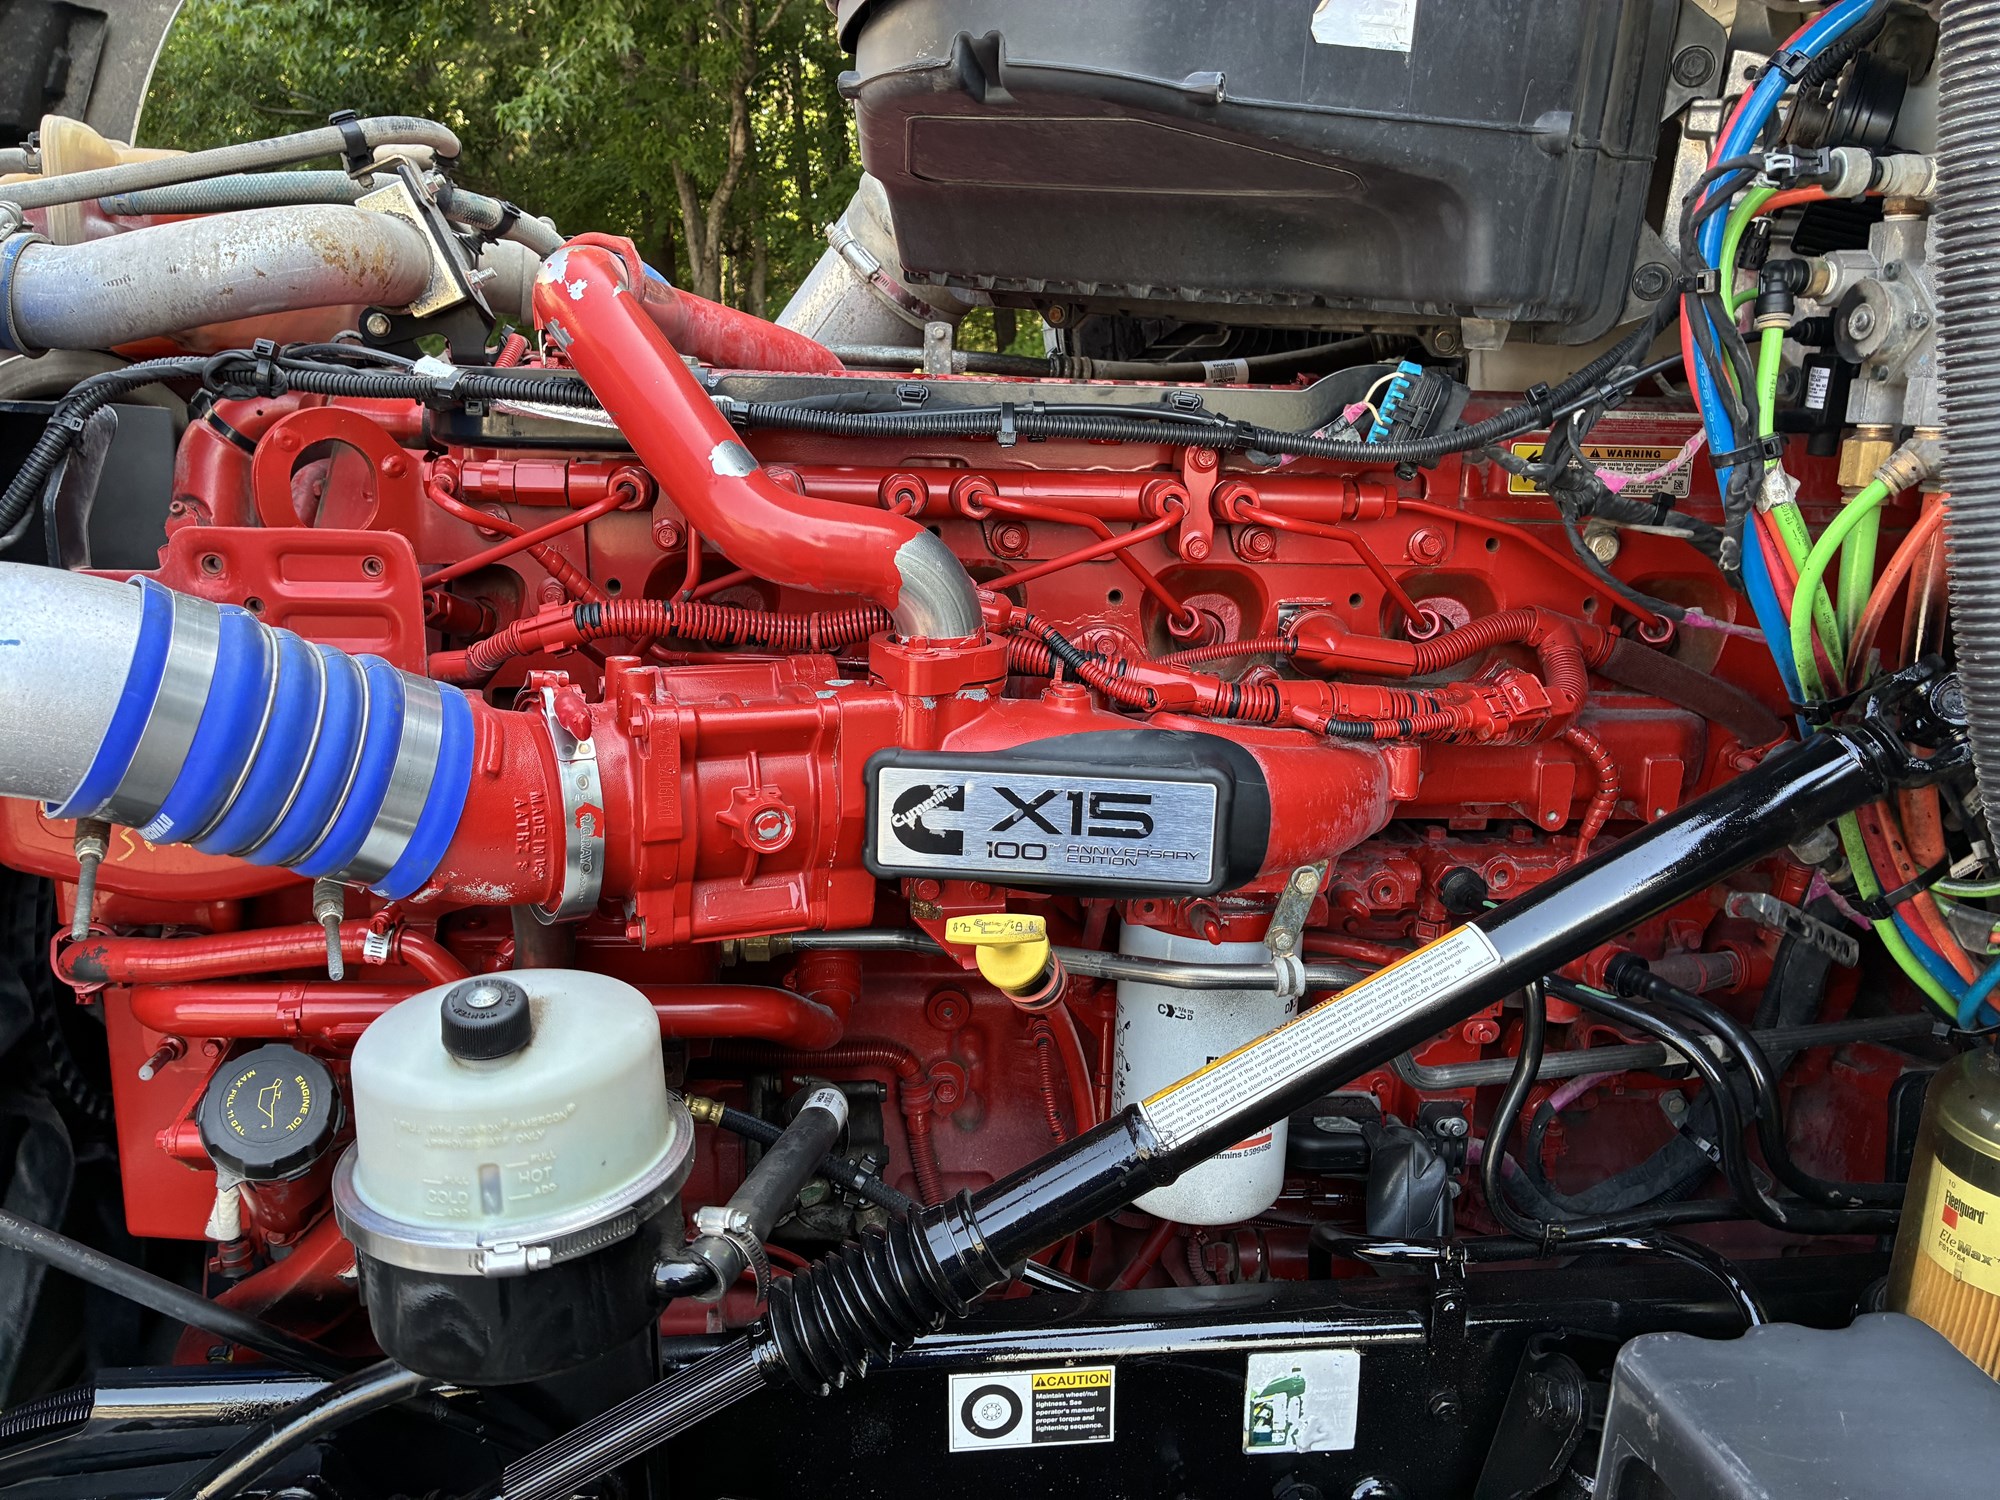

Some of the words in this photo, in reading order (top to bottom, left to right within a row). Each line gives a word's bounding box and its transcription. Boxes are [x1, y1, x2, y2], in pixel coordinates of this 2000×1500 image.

[1606, 449, 1661, 459] WARNING
[891, 785, 959, 828] Cummins
[988, 786, 1154, 839] X15
[1066, 843, 1200, 861] ANNIVERSARY
[1066, 854, 1138, 867] EDITION
[1149, 1099, 1179, 1119] repaired,
[1177, 1084, 1205, 1103] removed
[1211, 1056, 1254, 1083] disassembled
[1260, 1047, 1272, 1057] any
[1272, 1038, 1288, 1051] way,
[1299, 1024, 1311, 1034] the
[1310, 1010, 1337, 1029] steering
[1335, 1000, 1354, 1015] angle
[1353, 989, 1375, 1004] sensor
[1380, 968, 1411, 990] replaced,
[1409, 962, 1421, 972] the
[1420, 948, 1447, 968] steering
[1445, 939, 1464, 953] angle
[1153, 1109, 1176, 1125] sensor
[1174, 1099, 1192, 1113] must
[1199, 1073, 1238, 1099] recalibrated.
[1242, 1064, 1255, 1075] the
[1253, 1042, 1293, 1069] recalibration
[1297, 1033, 1310, 1044] not
[1309, 1015, 1343, 1039] performed
[1341, 1009, 1353, 1019] the
[1352, 995, 1378, 1014] stability
[1376, 982, 1400, 1000] control
[1398, 970, 1423, 988] system
[1421, 963, 1434, 974] will
[1432, 957, 1445, 968] not
[1443, 943, 1471, 962] function
[1184, 1101, 1205, 1117] which
[1203, 1095, 1219, 1108] may
[1216, 1083, 1236, 1099] result
[1246, 1069, 1262, 1082] loss
[1267, 1053, 1291, 1070] control
[1297, 1042, 1314, 1055] your
[1311, 1028, 1335, 1045] vehicle
[1333, 1021, 1348, 1033] and
[1346, 1006, 1375, 1027] personal
[1373, 996, 1393, 1012] injury
[1398, 980, 1420, 996] death.
[1418, 973, 1434, 986] Any
[1431, 961, 1455, 979] repairs
[1203, 1106, 1217, 1118] any
[1214, 1097, 1230, 1111] part
[1235, 1087, 1248, 1098] the
[1246, 1073, 1274, 1093] steering
[1271, 1060, 1296, 1079] system
[1294, 1051, 1312, 1065] must
[1319, 1028, 1353, 1052] performed
[1368, 1000, 1403, 1023] authorized
[1401, 984, 1431, 1005] PACCAR
[1429, 972, 1453, 989] dealer.
[1185, 1081, 1196, 1091] the
[1195, 1067, 1221, 1086] steering
[1220, 1055, 1244, 1072] system
[1280, 1020, 1307, 1038] steering
[236, 1070, 256, 1088] MAX
[226, 1089, 238, 1107] FILL
[295, 1075, 310, 1115] ENGINE
[231, 1119, 245, 1136] GAL
[285, 1116, 303, 1131] OIL
[515, 1129, 545, 1144] ONLY
[518, 1166, 553, 1183] HOT
[427, 1188, 469, 1205] COLD
[1944, 1189, 1985, 1225] Fleetguard
[1047, 1374, 1109, 1386] CAUTION
